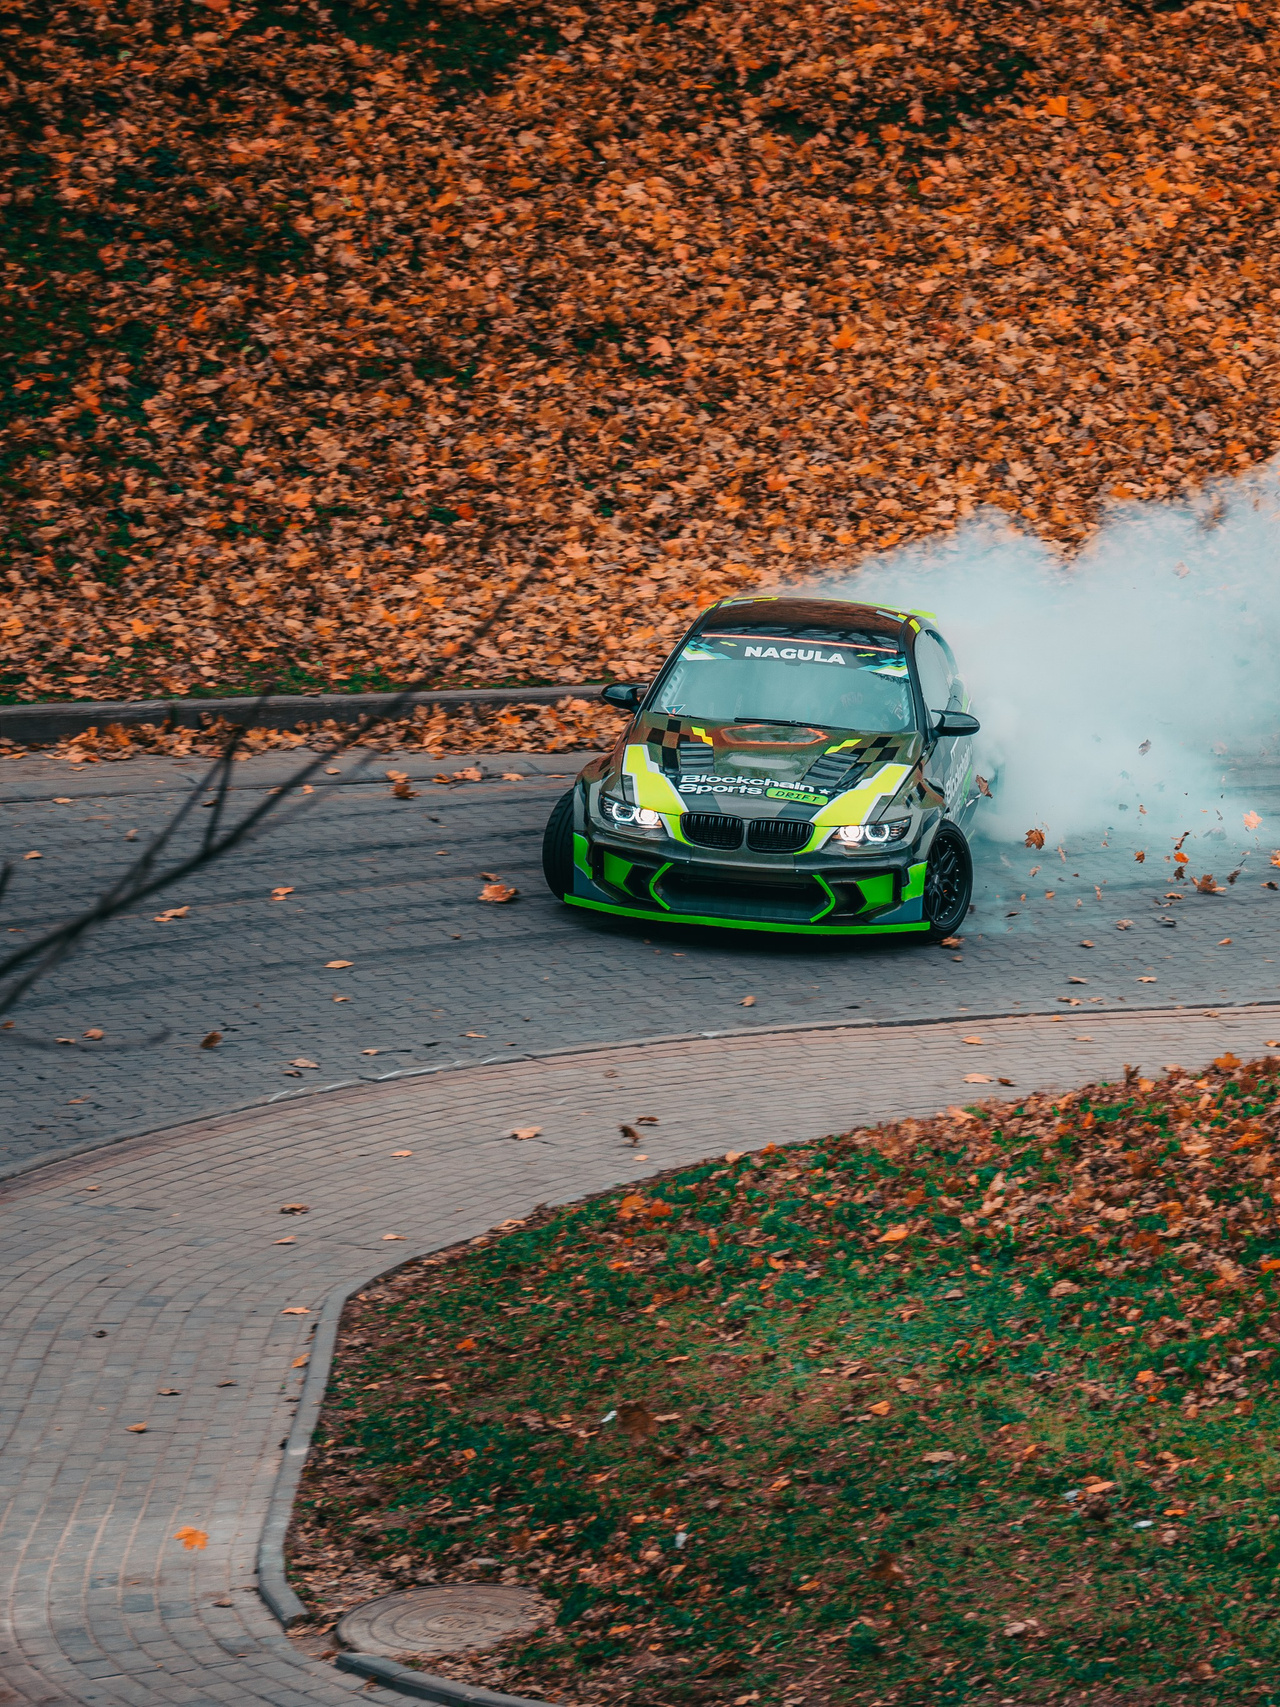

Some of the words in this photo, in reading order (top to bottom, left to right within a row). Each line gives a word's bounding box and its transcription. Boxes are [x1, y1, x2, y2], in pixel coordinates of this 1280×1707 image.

[744, 646, 846, 665] NAGULA
[677, 783, 764, 796] Sports
[775, 790, 820, 803] DRIFT
[680, 774, 815, 793] Blockchain
